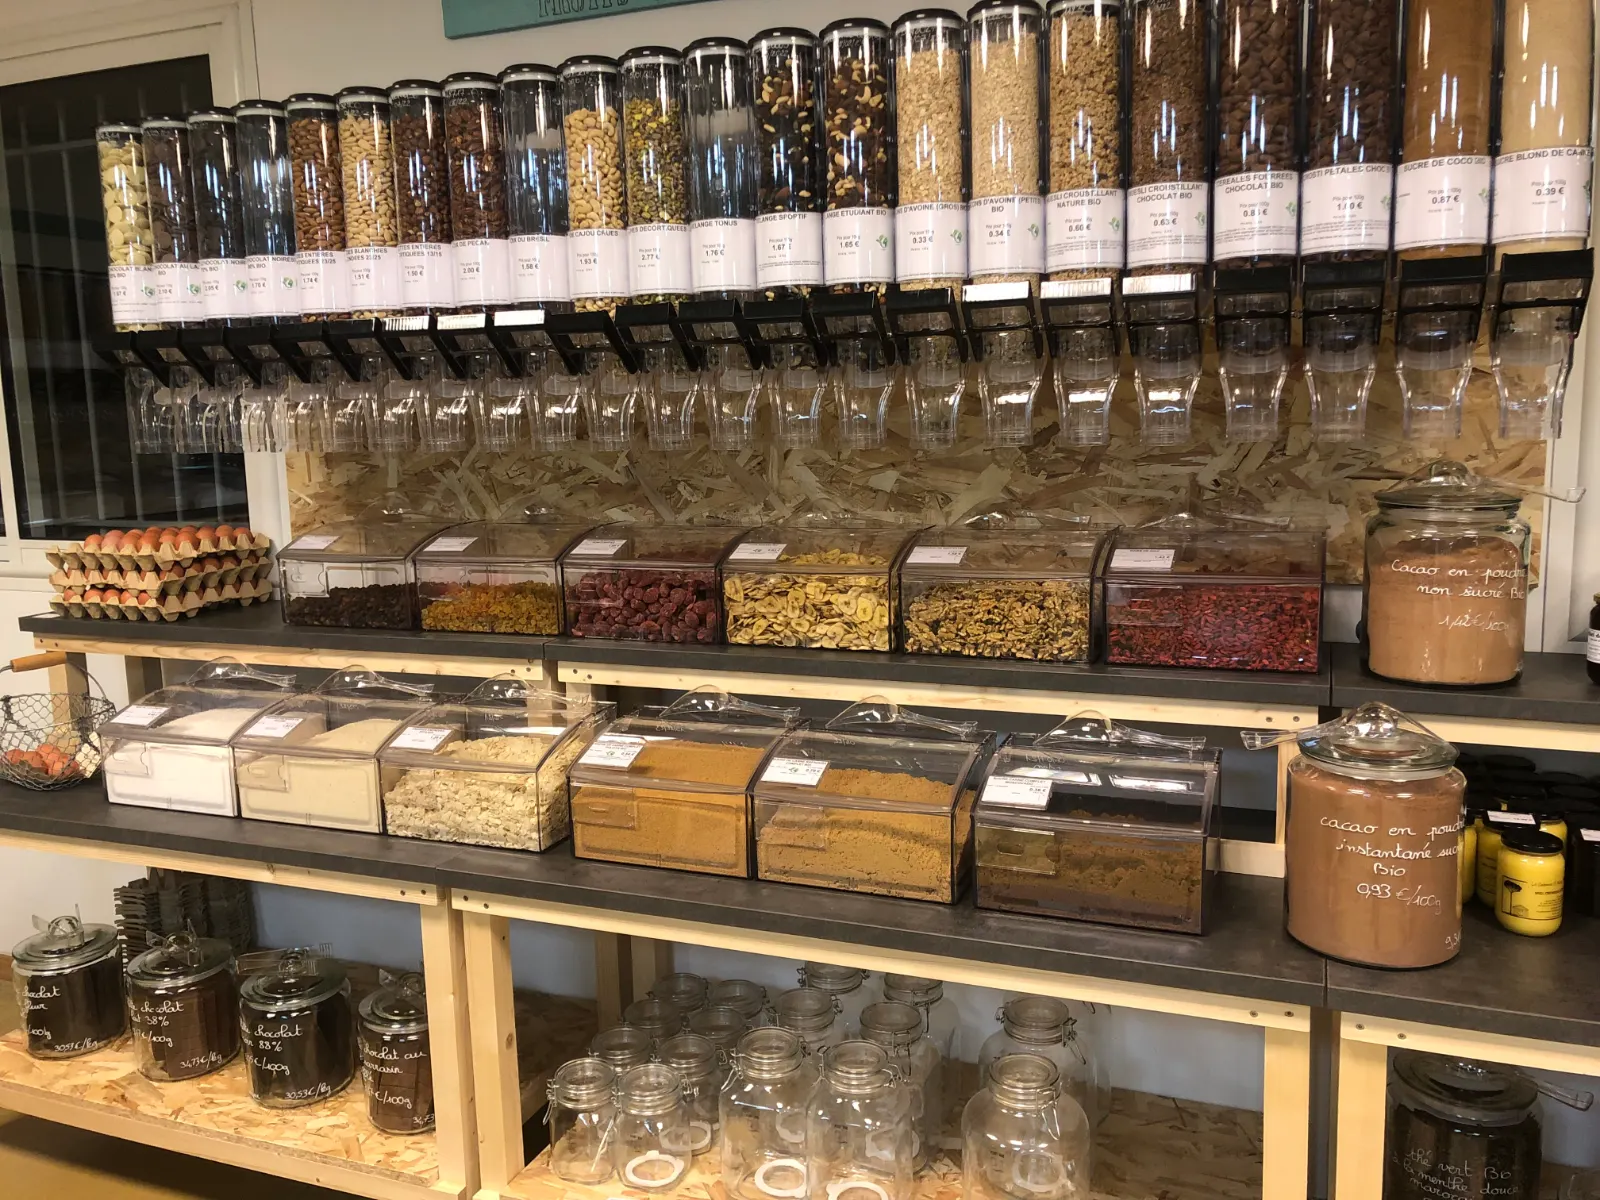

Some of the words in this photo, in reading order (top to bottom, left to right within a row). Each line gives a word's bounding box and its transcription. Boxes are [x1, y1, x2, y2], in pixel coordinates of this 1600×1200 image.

[1516, 150, 1549, 161] BLOND
[1552, 149, 1565, 157] DE
[1403, 160, 1428, 172] SUCRE
[1432, 159, 1445, 168] DE
[1447, 157, 1474, 166] COCO
[1325, 167, 1365, 176] PETALES
[1225, 183, 1268, 195] CHOCOLAT
[1270, 181, 1284, 189] BIO
[1536, 188, 1556, 197] 0.39
[1558, 187, 1564, 195] €
[1136, 193, 1177, 204] CHOCOLAT
[1179, 192, 1193, 200] BIO
[1432, 195, 1452, 205] 0.87
[1453, 194, 1461, 203] €
[1057, 199, 1085, 209] NATURE
[1087, 199, 1101, 207] BIO
[1357, 201, 1363, 210] €
[778, 212, 808, 221] SPORTIF
[876, 208, 887, 217] BIO
[1262, 208, 1268, 216] €
[715, 218, 739, 227] TONUS
[1172, 217, 1178, 225] €
[1085, 223, 1092, 231] €
[575, 230, 596, 238] CAJOU
[988, 230, 1004, 238] 0.34
[839, 241, 854, 249] 1.65
[854, 239, 860, 248] €
[912, 236, 927, 245] 0.33
[354, 247, 388, 255] BLANCHIES
[411, 243, 442, 251] ENTIERES
[772, 244, 786, 252] 1.67
[641, 253, 655, 261] 2.77
[705, 249, 719, 257] 1.76
[719, 248, 725, 256] €
[475, 265, 480, 273] €
[366, 272, 371, 280] €
[1391, 559, 1440, 576] Cacao
[1448, 567, 1473, 577] en
[1416, 584, 1453, 596] non
[1459, 582, 1505, 599] sucré
[1320, 815, 1378, 834] cacao
[1388, 826, 1418, 836] en
[1335, 838, 1434, 860] instantané
[1373, 862, 1406, 876] Bio
[1356, 883, 1392, 904] 0,93
[140, 1000, 184, 1013] chocolat
[145, 1015, 170, 1027] 38%
[254, 1024, 304, 1038] chocolat
[258, 1040, 283, 1052] 88%
[404, 1050, 428, 1060] au
[1405, 1148, 1432, 1167] thé
[1437, 1160, 1473, 1177] vert
[1417, 1171, 1469, 1194] menthe
